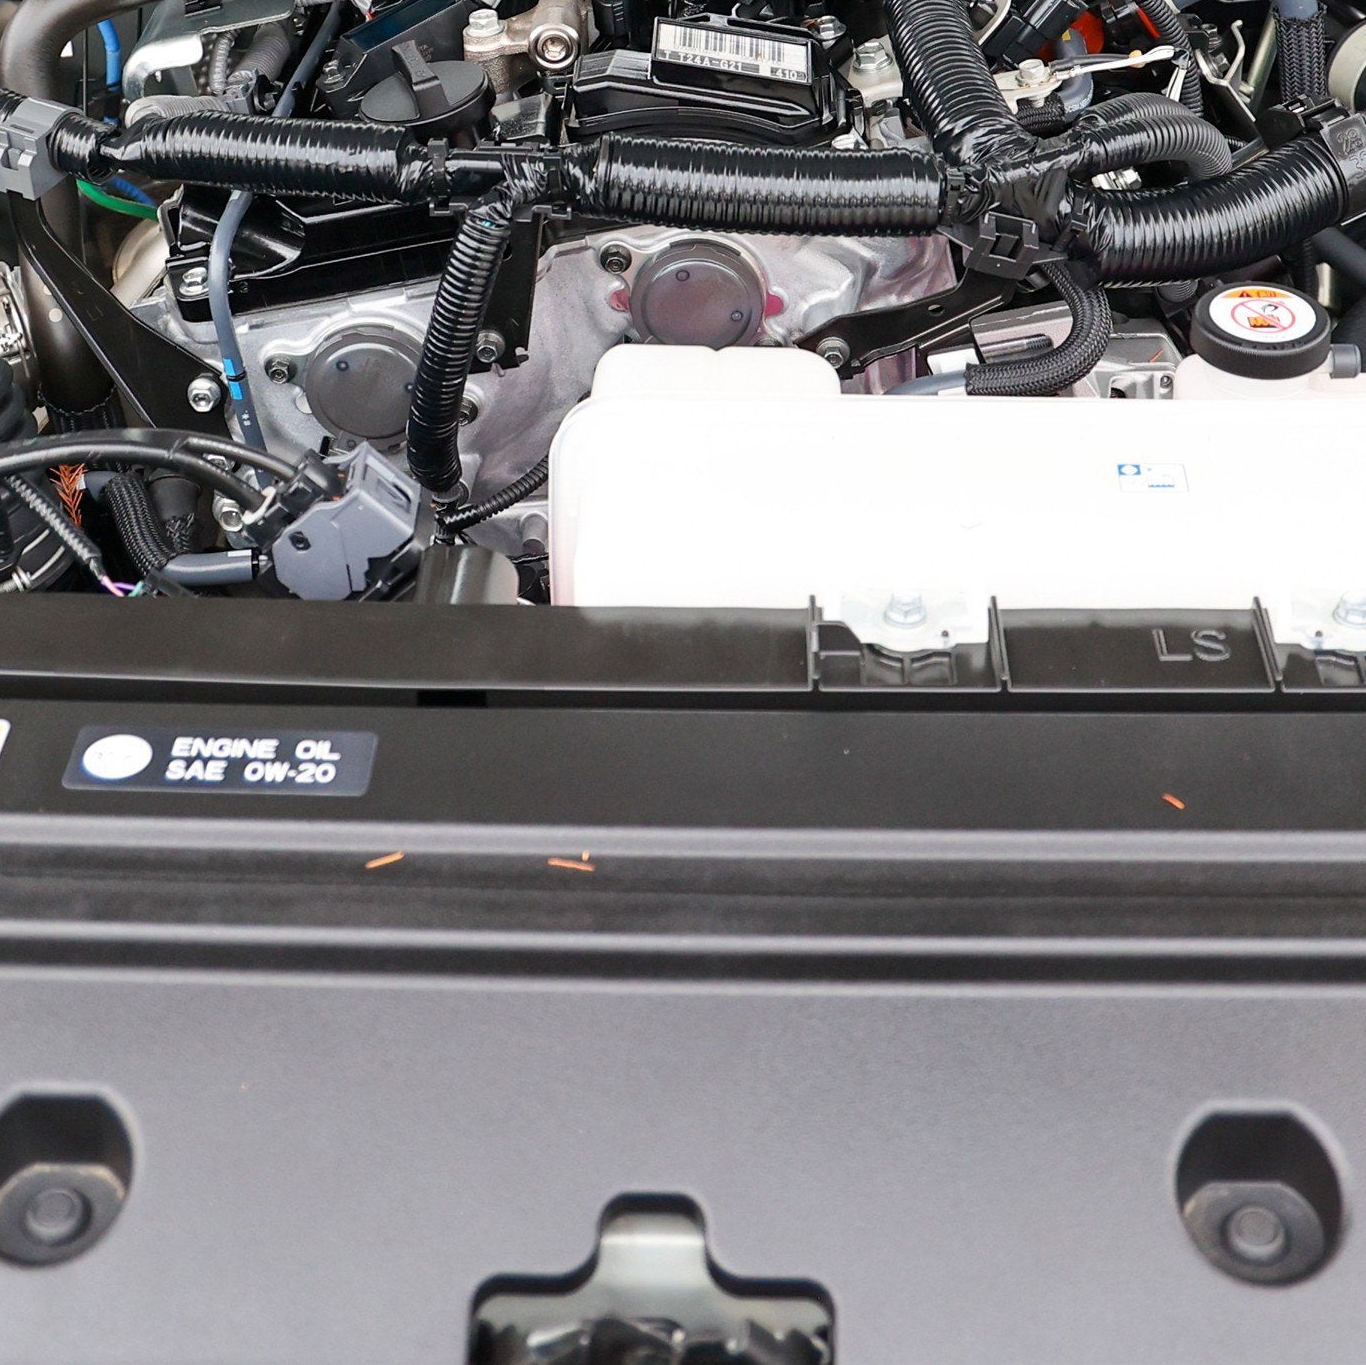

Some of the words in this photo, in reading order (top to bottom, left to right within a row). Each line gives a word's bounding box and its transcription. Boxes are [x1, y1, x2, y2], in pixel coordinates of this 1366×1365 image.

[678, 51, 744, 71] T24A-G21
[1151, 627, 1231, 662] LS
[170, 736, 280, 760] ENGINE
[294, 739, 341, 761] OIL
[164, 758, 229, 782] SAE
[242, 760, 337, 784] 0W-20
